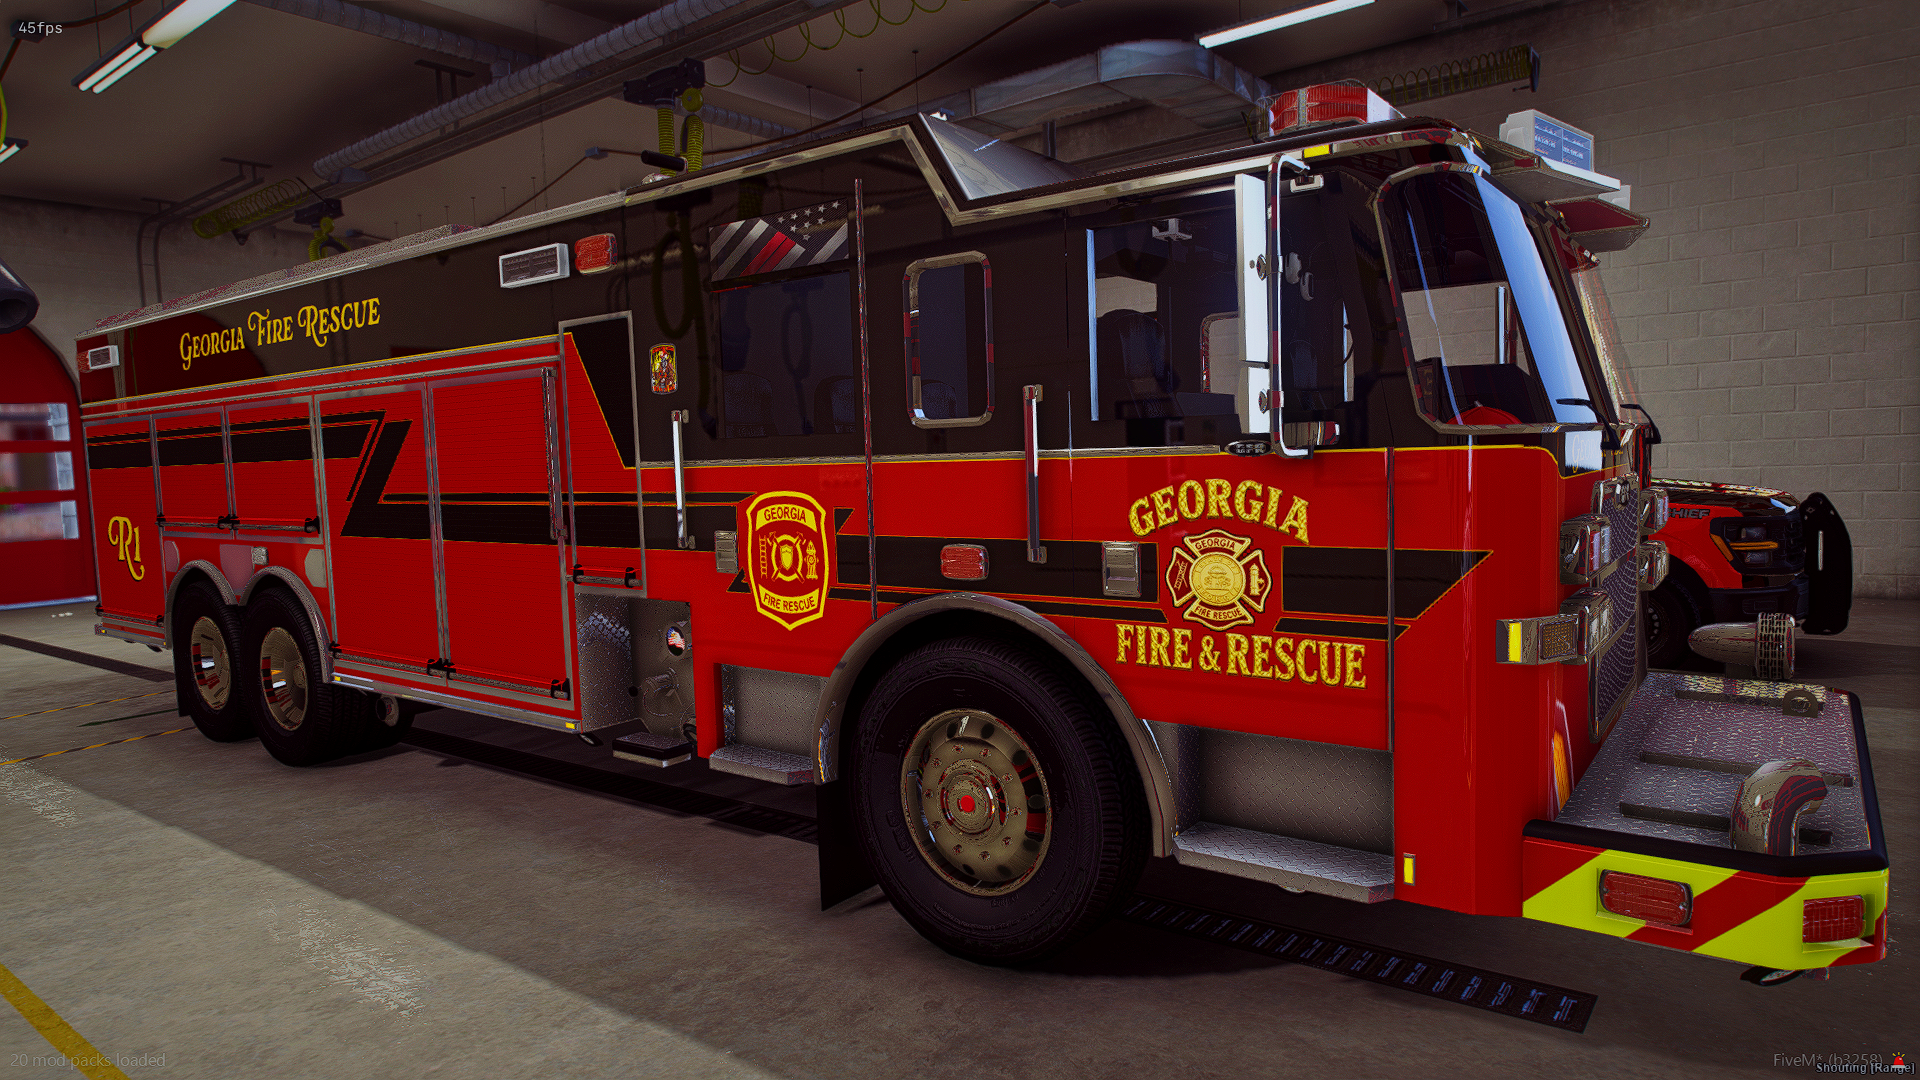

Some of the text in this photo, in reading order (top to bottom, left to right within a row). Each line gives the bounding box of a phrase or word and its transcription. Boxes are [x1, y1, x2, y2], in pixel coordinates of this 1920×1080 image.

[764, 506, 806, 523] GEORGIA
[1128, 478, 1310, 545] GEORGIA
[108, 516, 145, 581] R1
[1195, 538, 1235, 550] GEORGIA
[763, 592, 816, 612] FIRE RESCUE
[1194, 605, 1242, 619] FIRE RESCUE
[1115, 623, 1368, 689] FIRE & RESCUE
